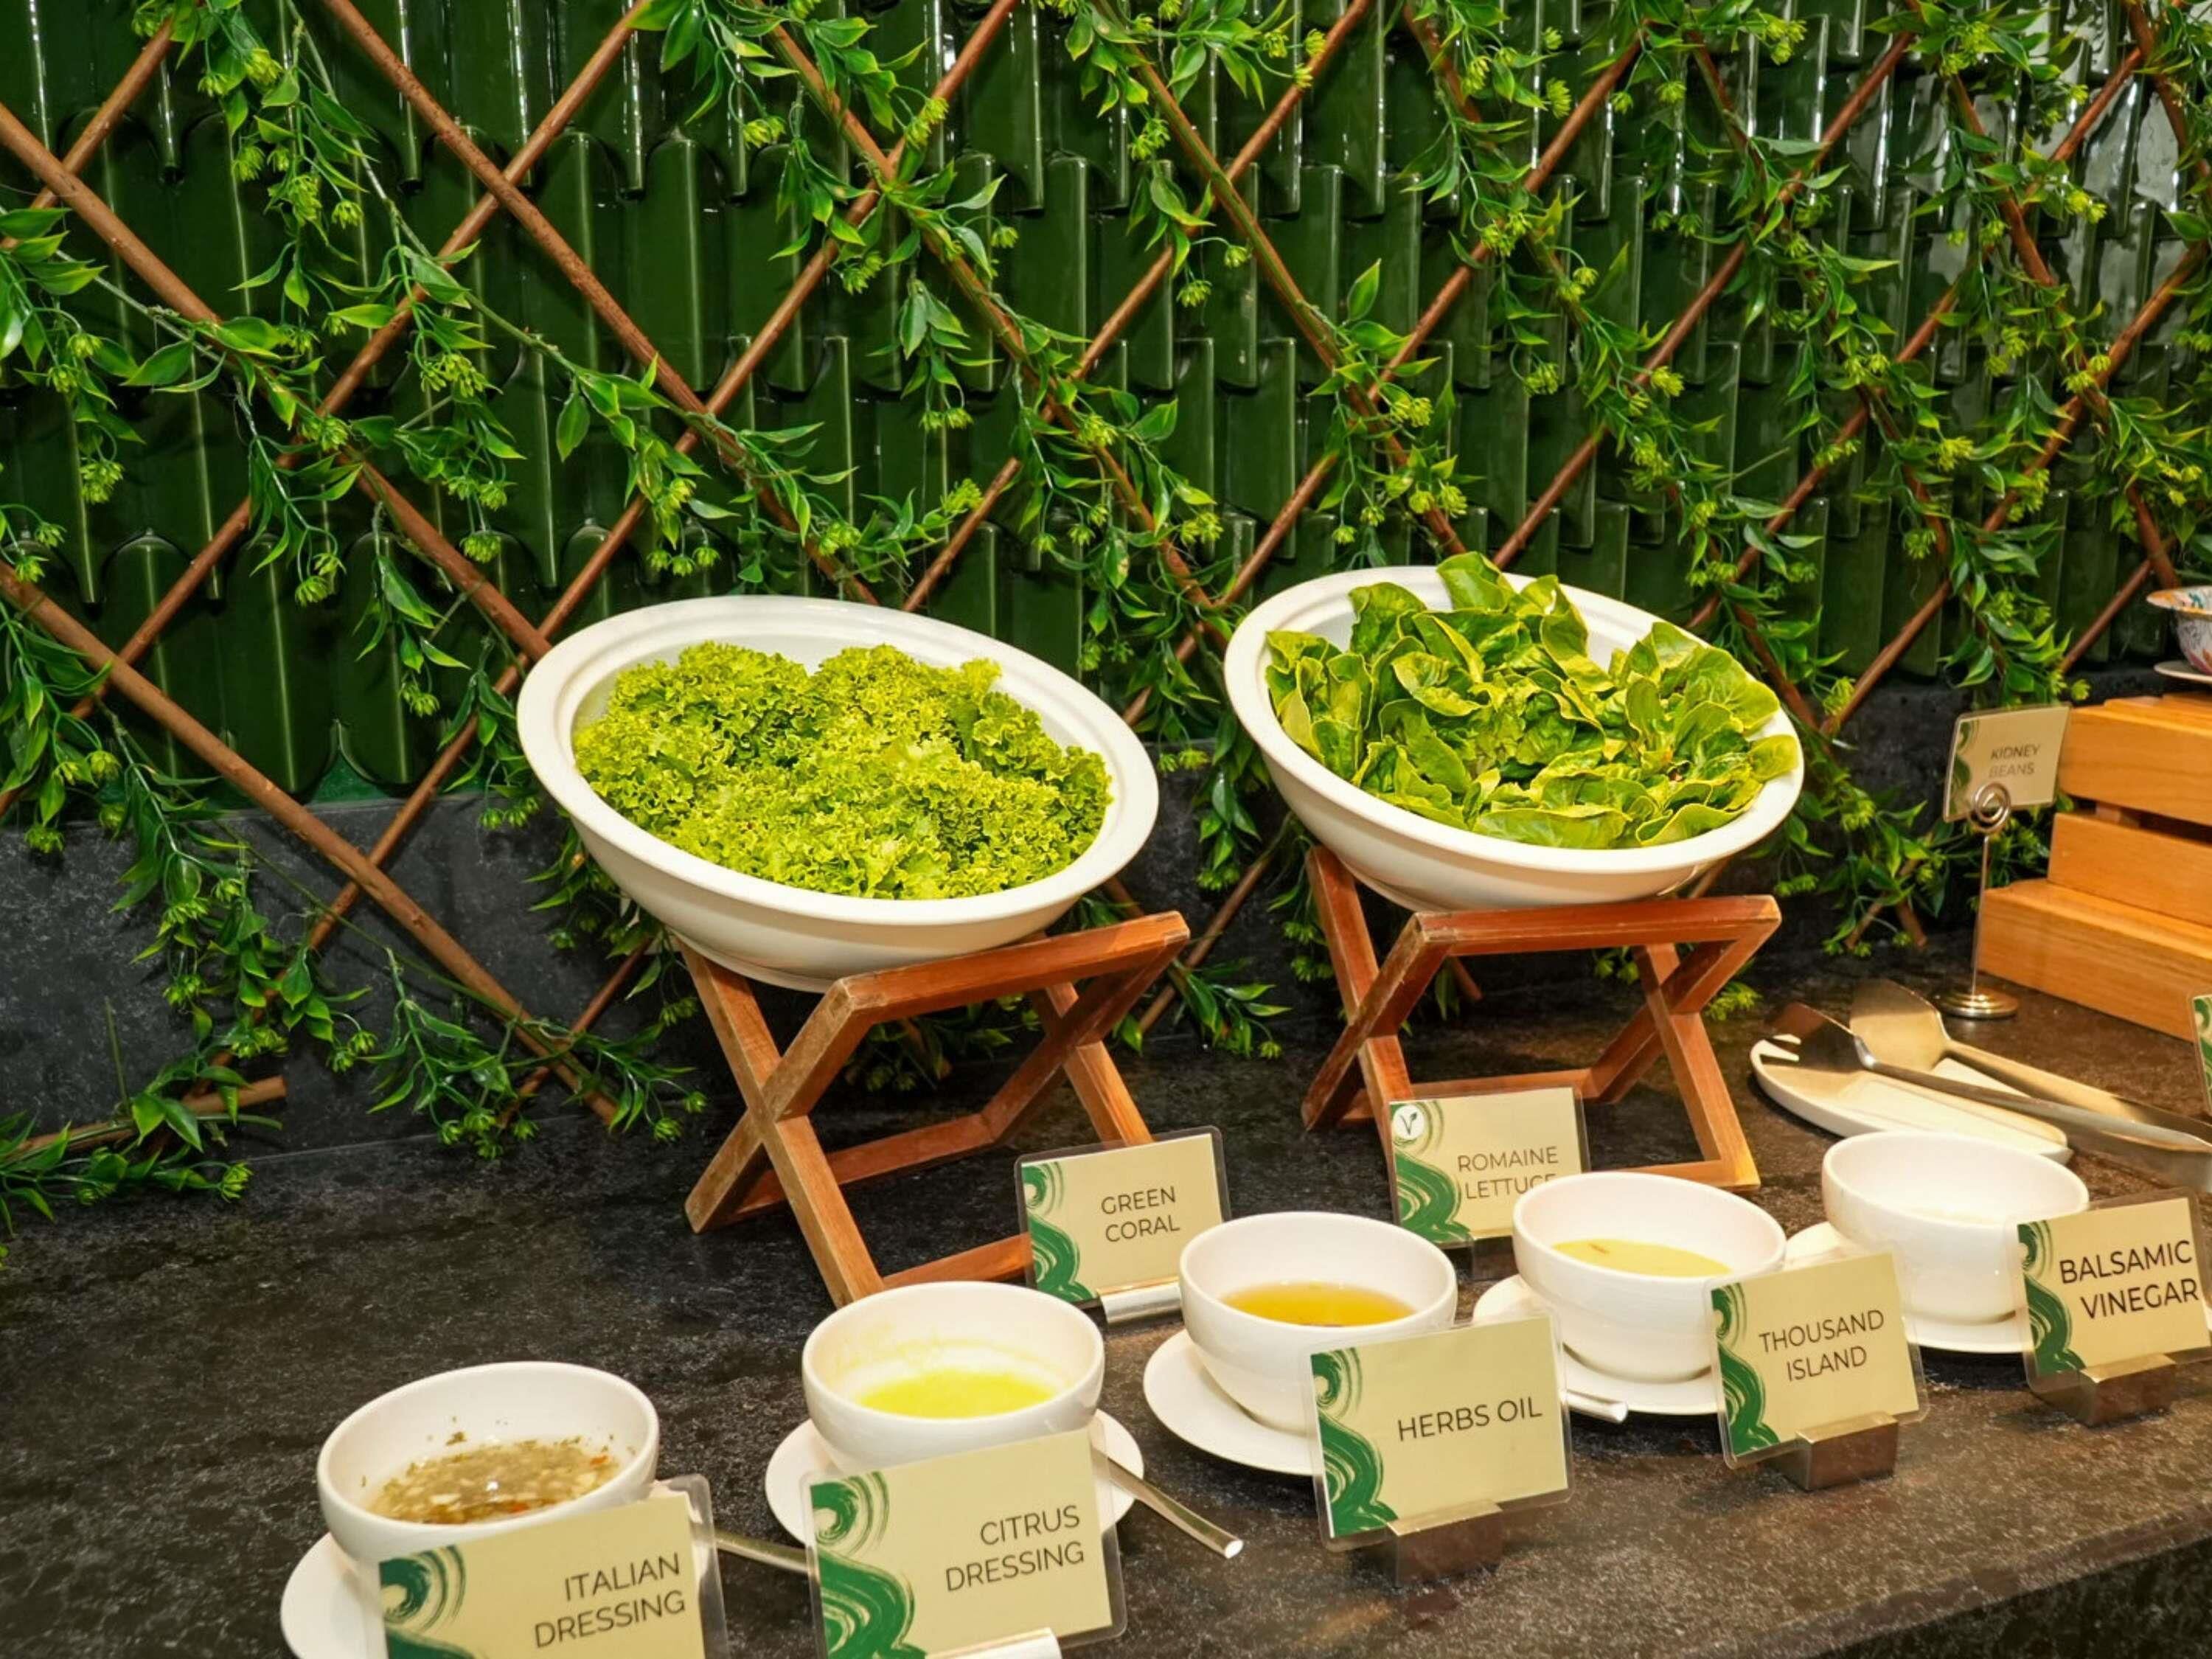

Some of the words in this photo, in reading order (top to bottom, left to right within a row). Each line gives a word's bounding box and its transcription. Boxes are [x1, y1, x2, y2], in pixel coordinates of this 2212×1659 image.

[1989, 762, 2035, 778] BEANS
[1991, 743, 2041, 760] KIDNEY
[1457, 1146, 1559, 1172] ROMAINE
[1101, 1185, 1177, 1214] GREEN
[1105, 1215, 1180, 1242] CORAL
[2059, 1239, 2193, 1284] BALSAMIC
[2080, 1278, 2199, 1320] VINEGAR
[1759, 1310, 1885, 1352] THOUSAND
[1787, 1345, 1868, 1382] ISLAND
[1397, 1404, 1490, 1442] HERBS
[1497, 1396, 1543, 1422] OIL
[980, 1505, 1081, 1545] CITRUS
[565, 1551, 681, 1601] ITALIAN
[945, 1541, 1085, 1592] DRESSING
[534, 1590, 686, 1649] DRESSING
